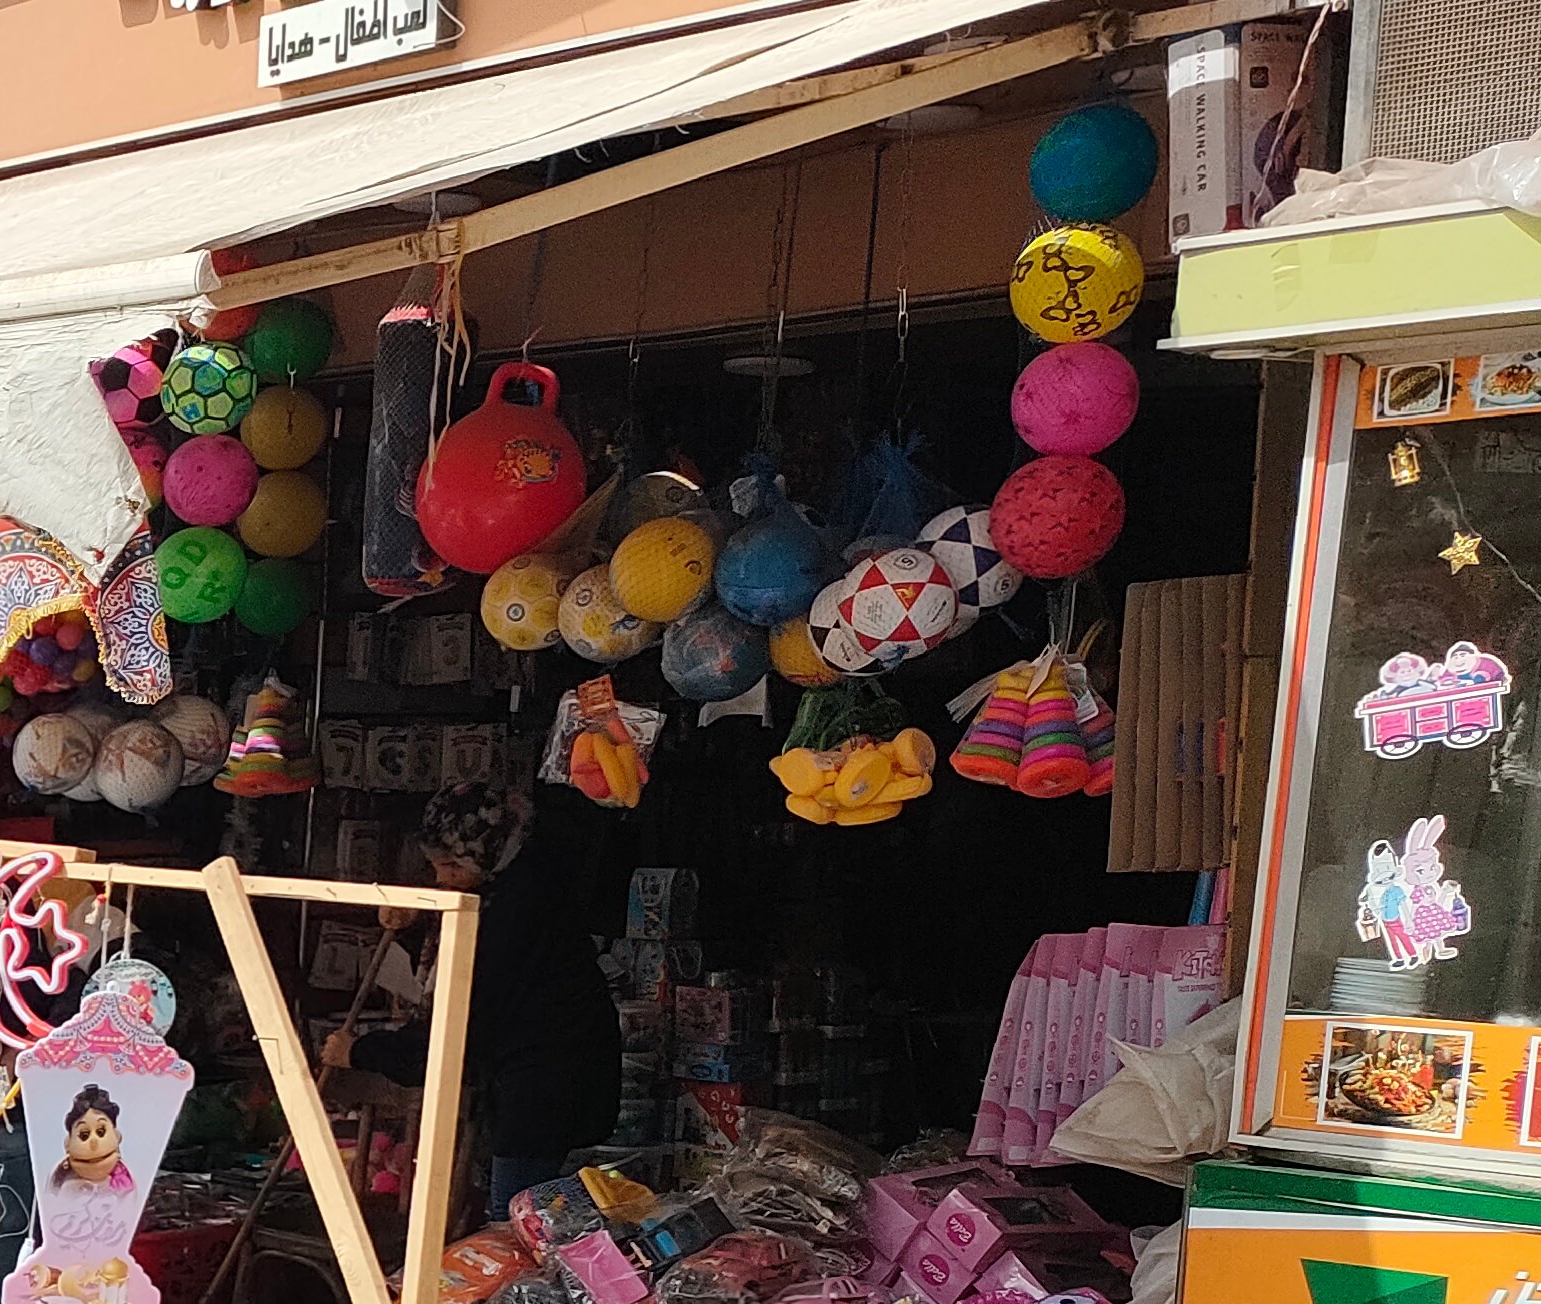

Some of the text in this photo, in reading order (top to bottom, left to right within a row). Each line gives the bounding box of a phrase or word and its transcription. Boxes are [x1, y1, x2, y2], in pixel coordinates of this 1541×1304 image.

[1195, 45, 1208, 192] SPACE WALKING CAR
